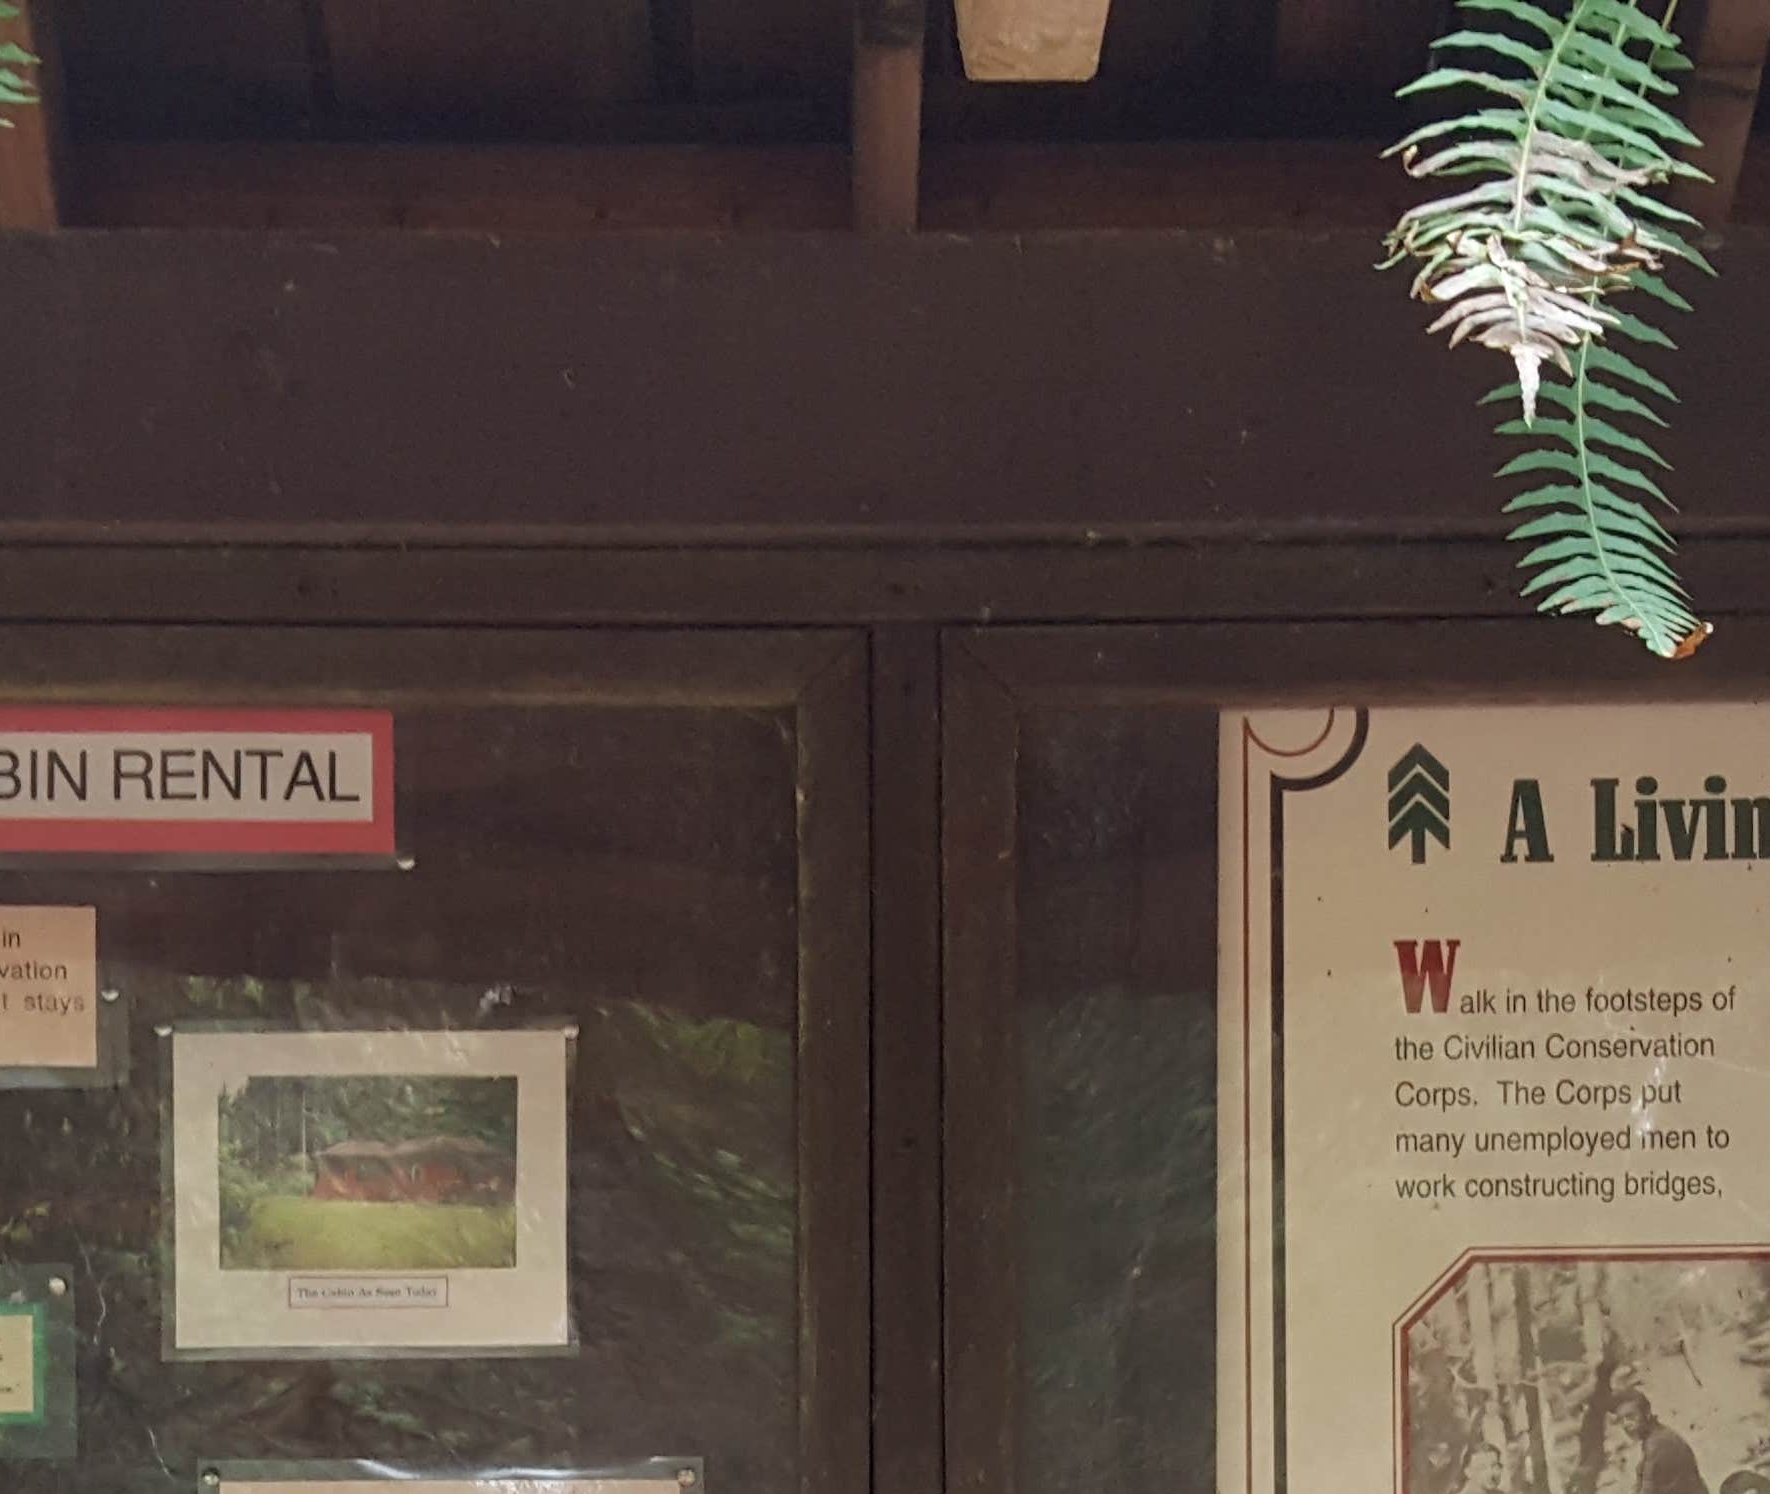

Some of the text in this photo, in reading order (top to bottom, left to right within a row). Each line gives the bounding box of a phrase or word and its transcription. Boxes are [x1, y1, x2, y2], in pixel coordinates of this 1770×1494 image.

[114, 750, 360, 803] RENTAL
[1499, 777, 1555, 864] A
[2, 926, 21, 949] in
[1394, 1032, 1715, 1061] the Civilian Conservation
[1394, 1077, 1682, 1114] Corps. The Corps put
